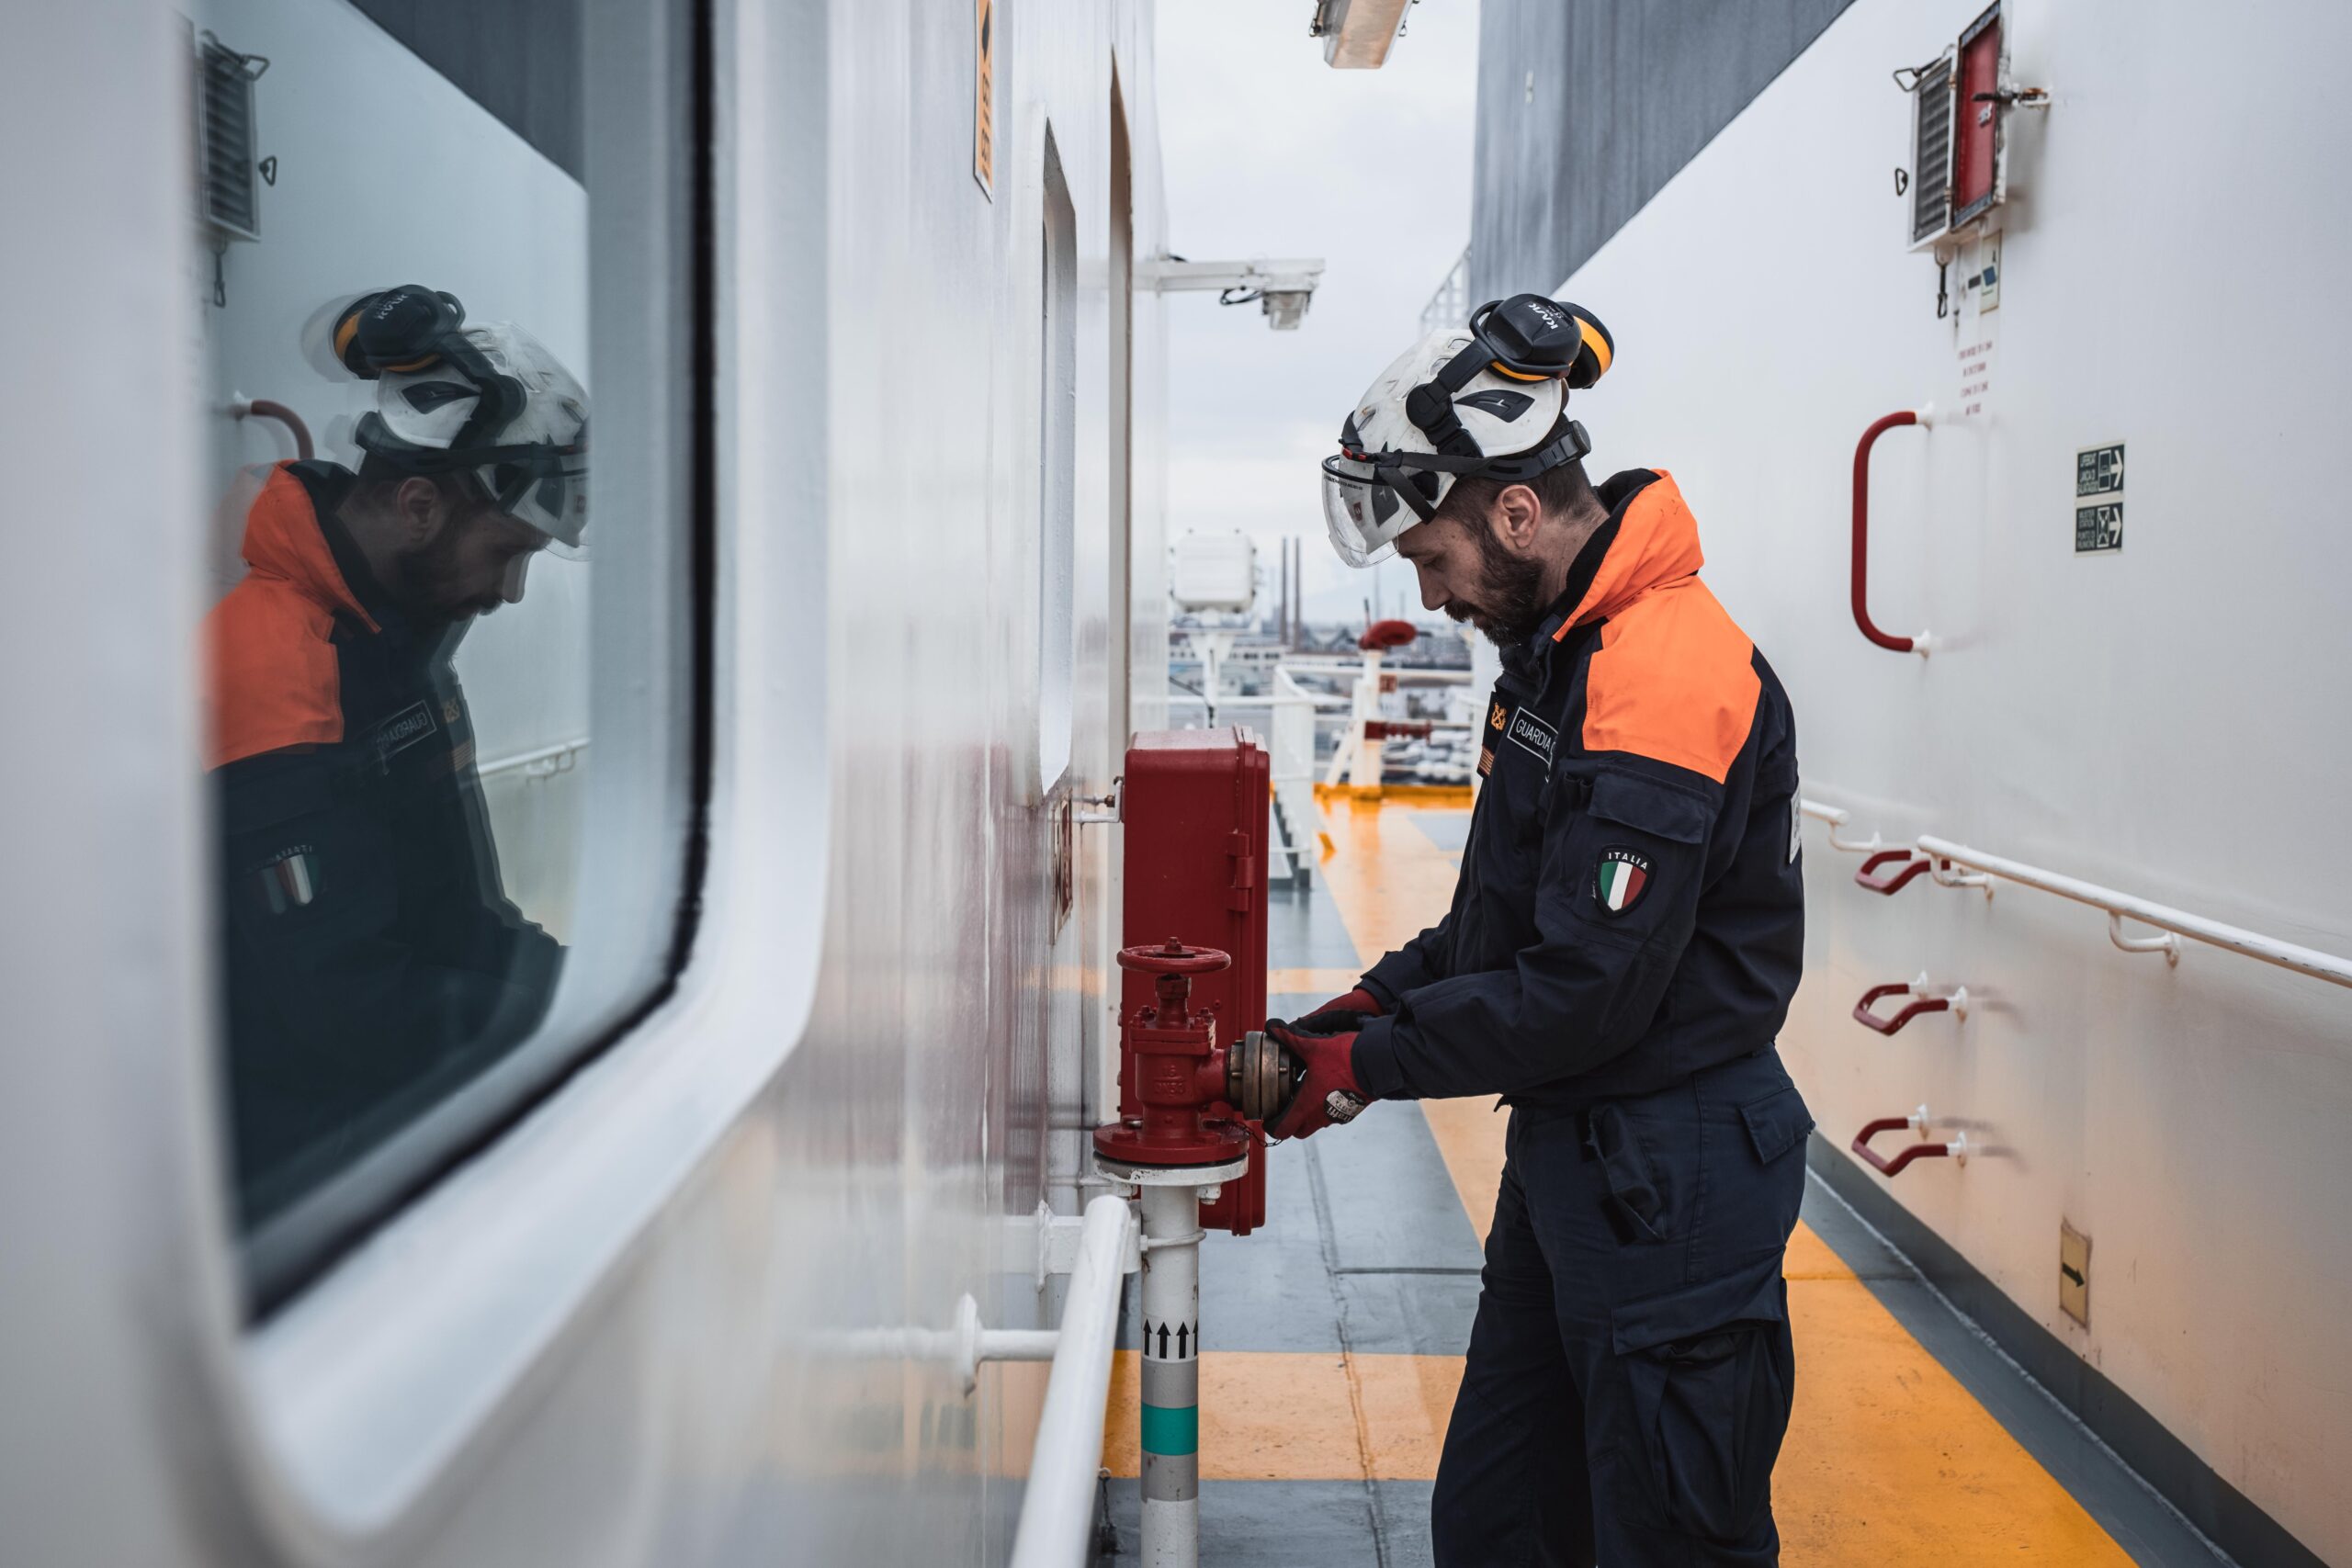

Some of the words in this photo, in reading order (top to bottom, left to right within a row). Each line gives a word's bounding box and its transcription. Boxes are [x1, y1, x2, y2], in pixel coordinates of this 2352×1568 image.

[1529, 303, 1558, 330] KASK
[1516, 718, 1552, 752] GUARDIA
[1608, 852, 1648, 870] ITALIA
